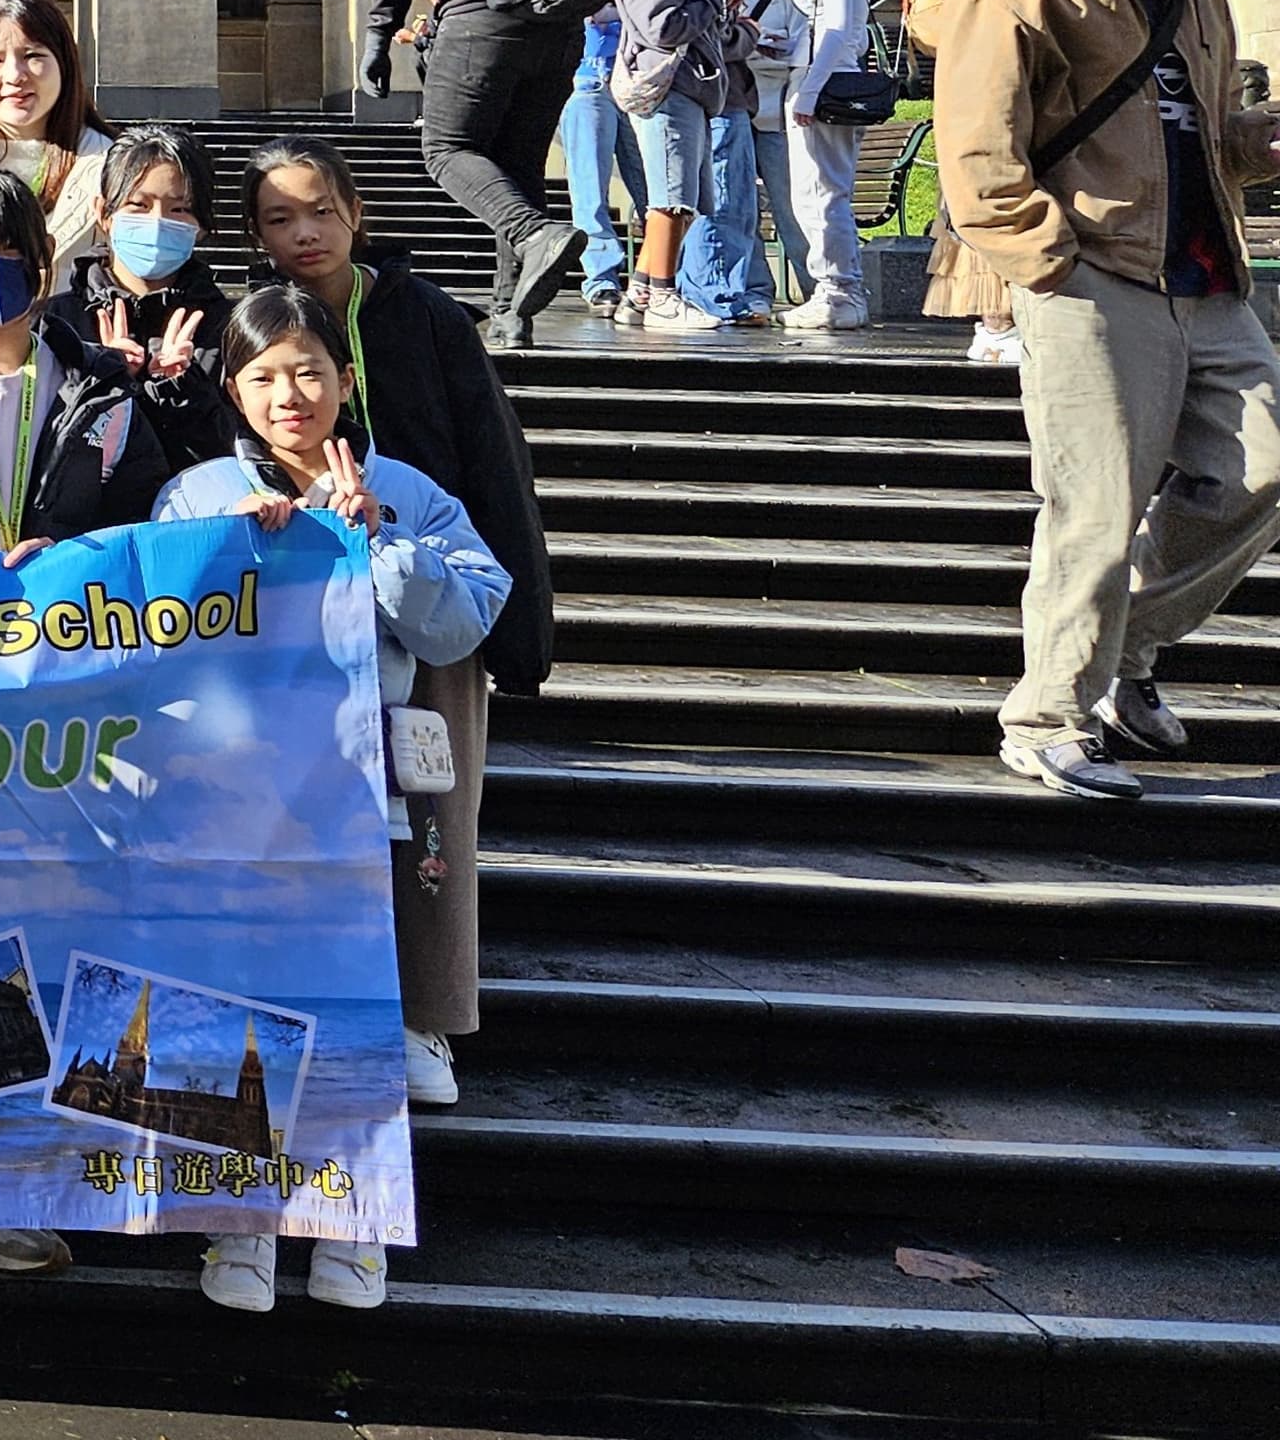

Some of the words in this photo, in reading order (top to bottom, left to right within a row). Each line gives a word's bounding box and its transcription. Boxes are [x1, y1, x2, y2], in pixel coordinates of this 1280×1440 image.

[83, 1150, 354, 1200] 專日遊學中心
